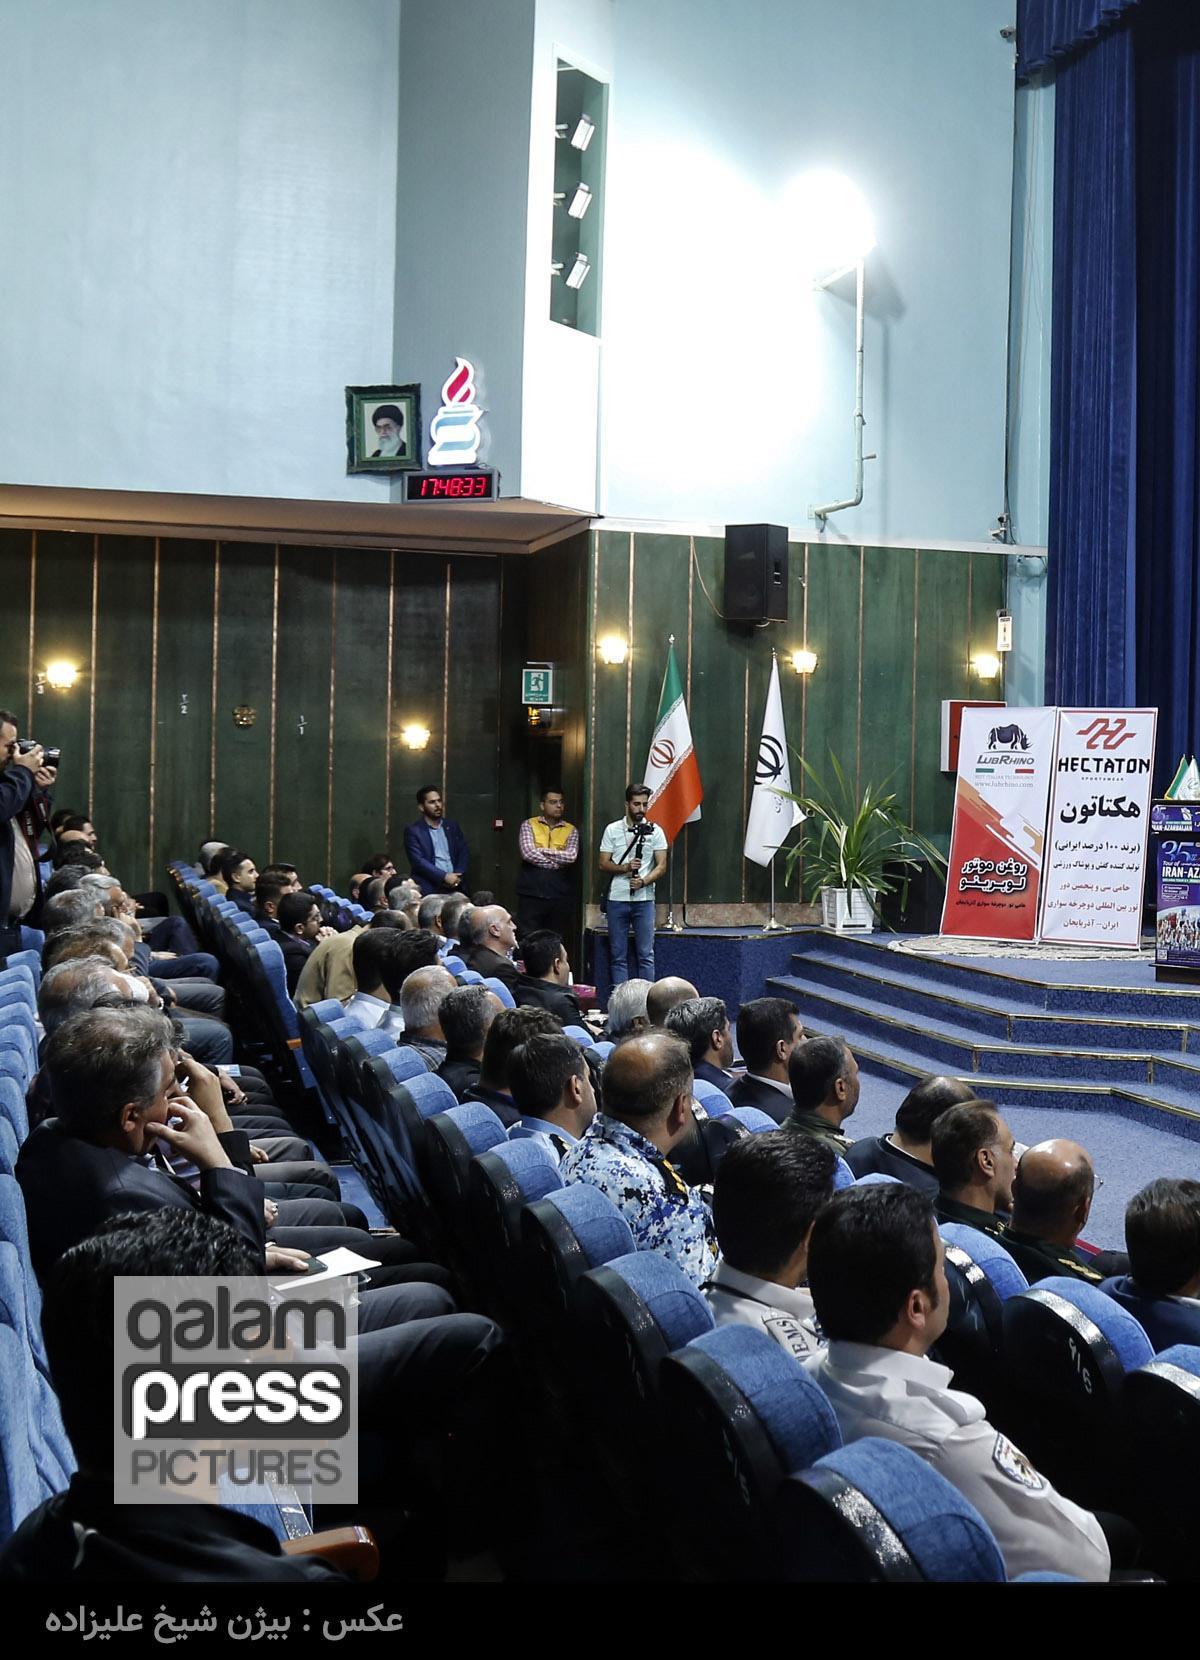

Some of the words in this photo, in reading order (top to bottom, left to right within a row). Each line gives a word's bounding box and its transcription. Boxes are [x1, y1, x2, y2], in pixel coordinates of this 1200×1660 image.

[421, 477, 486, 496] 17:48:33
[1058, 757, 1151, 774] HECTATON
[1060, 795, 1141, 824] هکتاتون
[961, 857, 994, 874] موتور
[996, 857, 1027, 876] روغن
